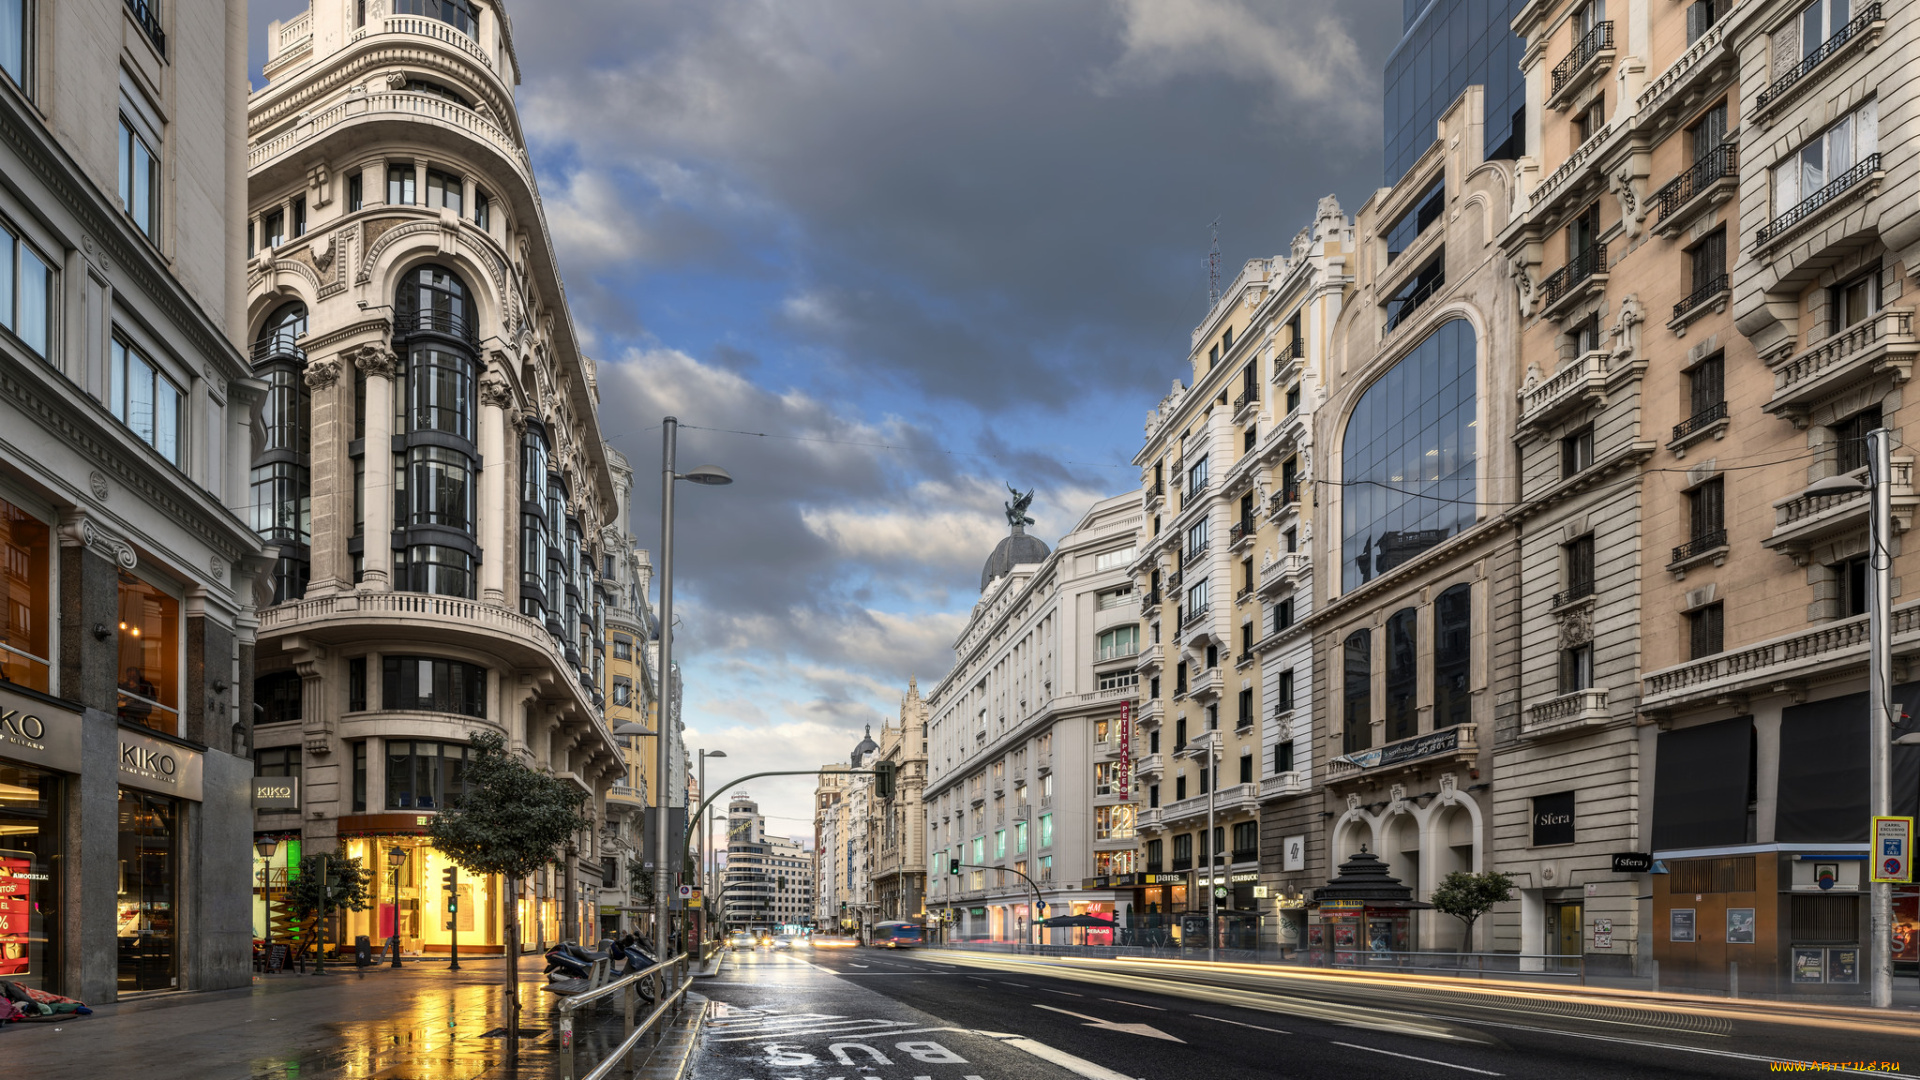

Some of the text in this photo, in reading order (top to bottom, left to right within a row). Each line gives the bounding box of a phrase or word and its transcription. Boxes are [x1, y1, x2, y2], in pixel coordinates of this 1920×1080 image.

[120, 742, 175, 775] KIKO
[257, 787, 291, 796] KIKO
[1155, 874, 1180, 883] pans
[1231, 874, 1258, 882] STARBUCK
[764, 1041, 971, 1066] BUS
